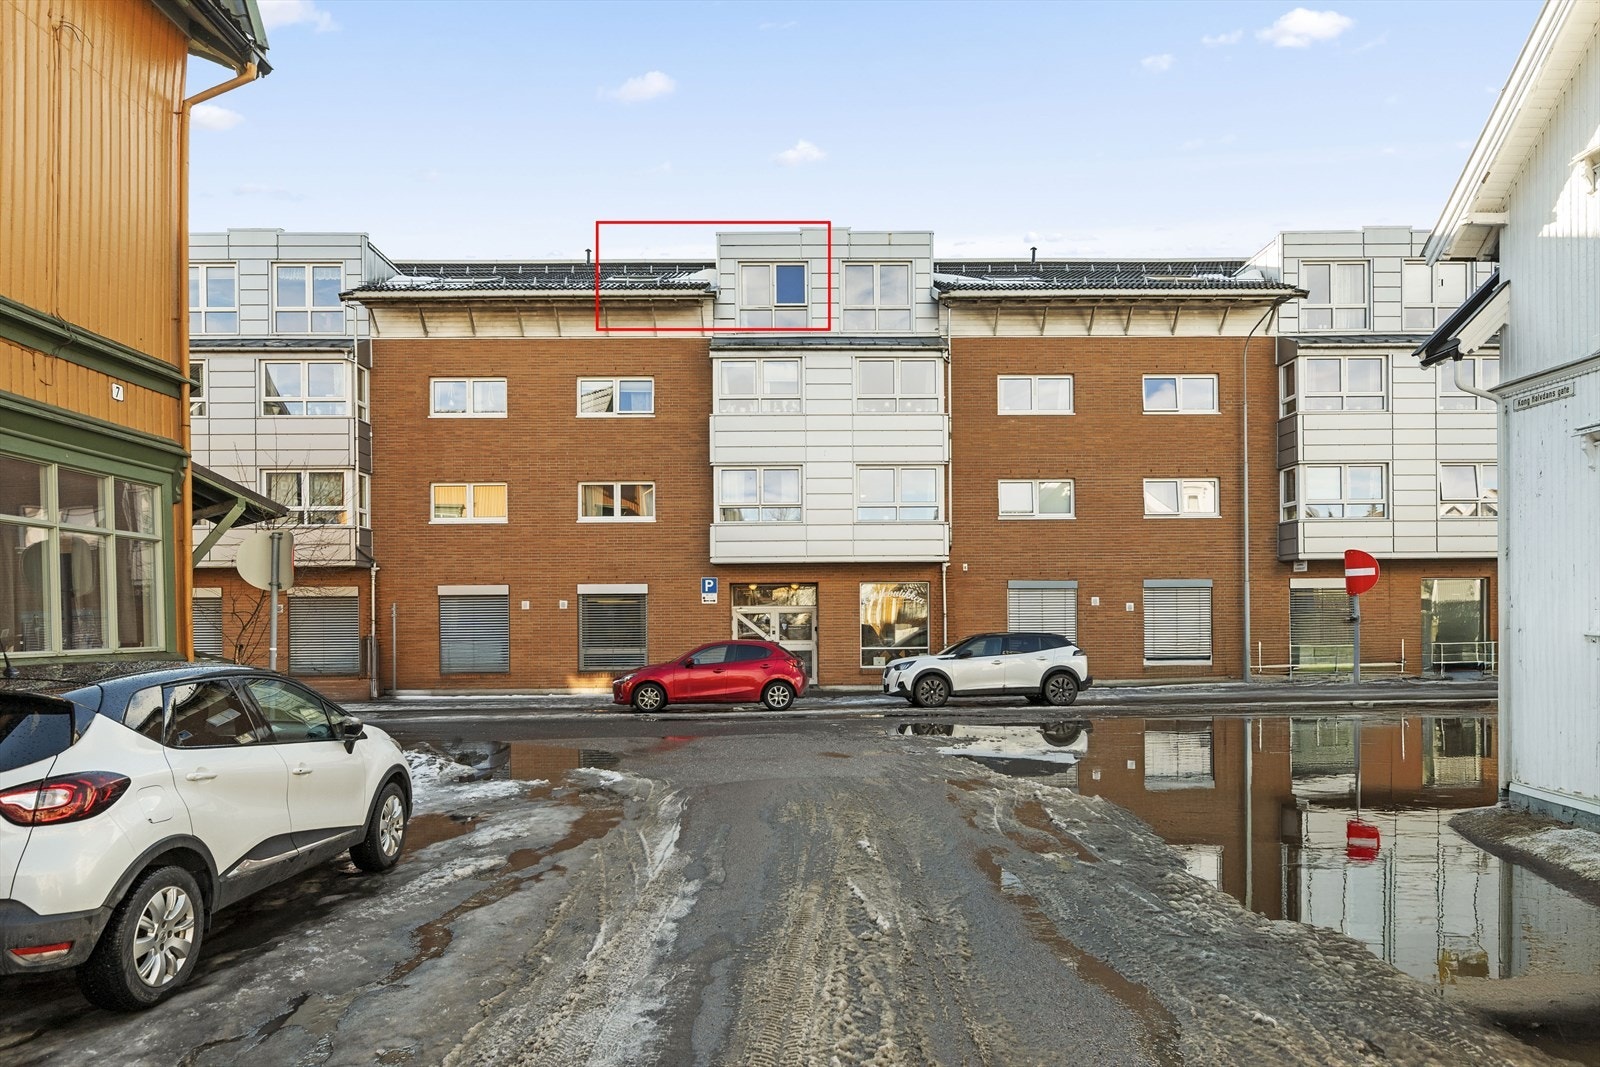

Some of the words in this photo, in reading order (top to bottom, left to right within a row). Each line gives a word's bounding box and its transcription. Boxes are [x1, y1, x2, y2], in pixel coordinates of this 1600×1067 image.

[115, 386, 120, 398] 7
[1517, 398, 1530, 407] Kong
[1531, 390, 1556, 403] Halvdans
[1557, 386, 1570, 397] gate
[705, 579, 714, 592] P
